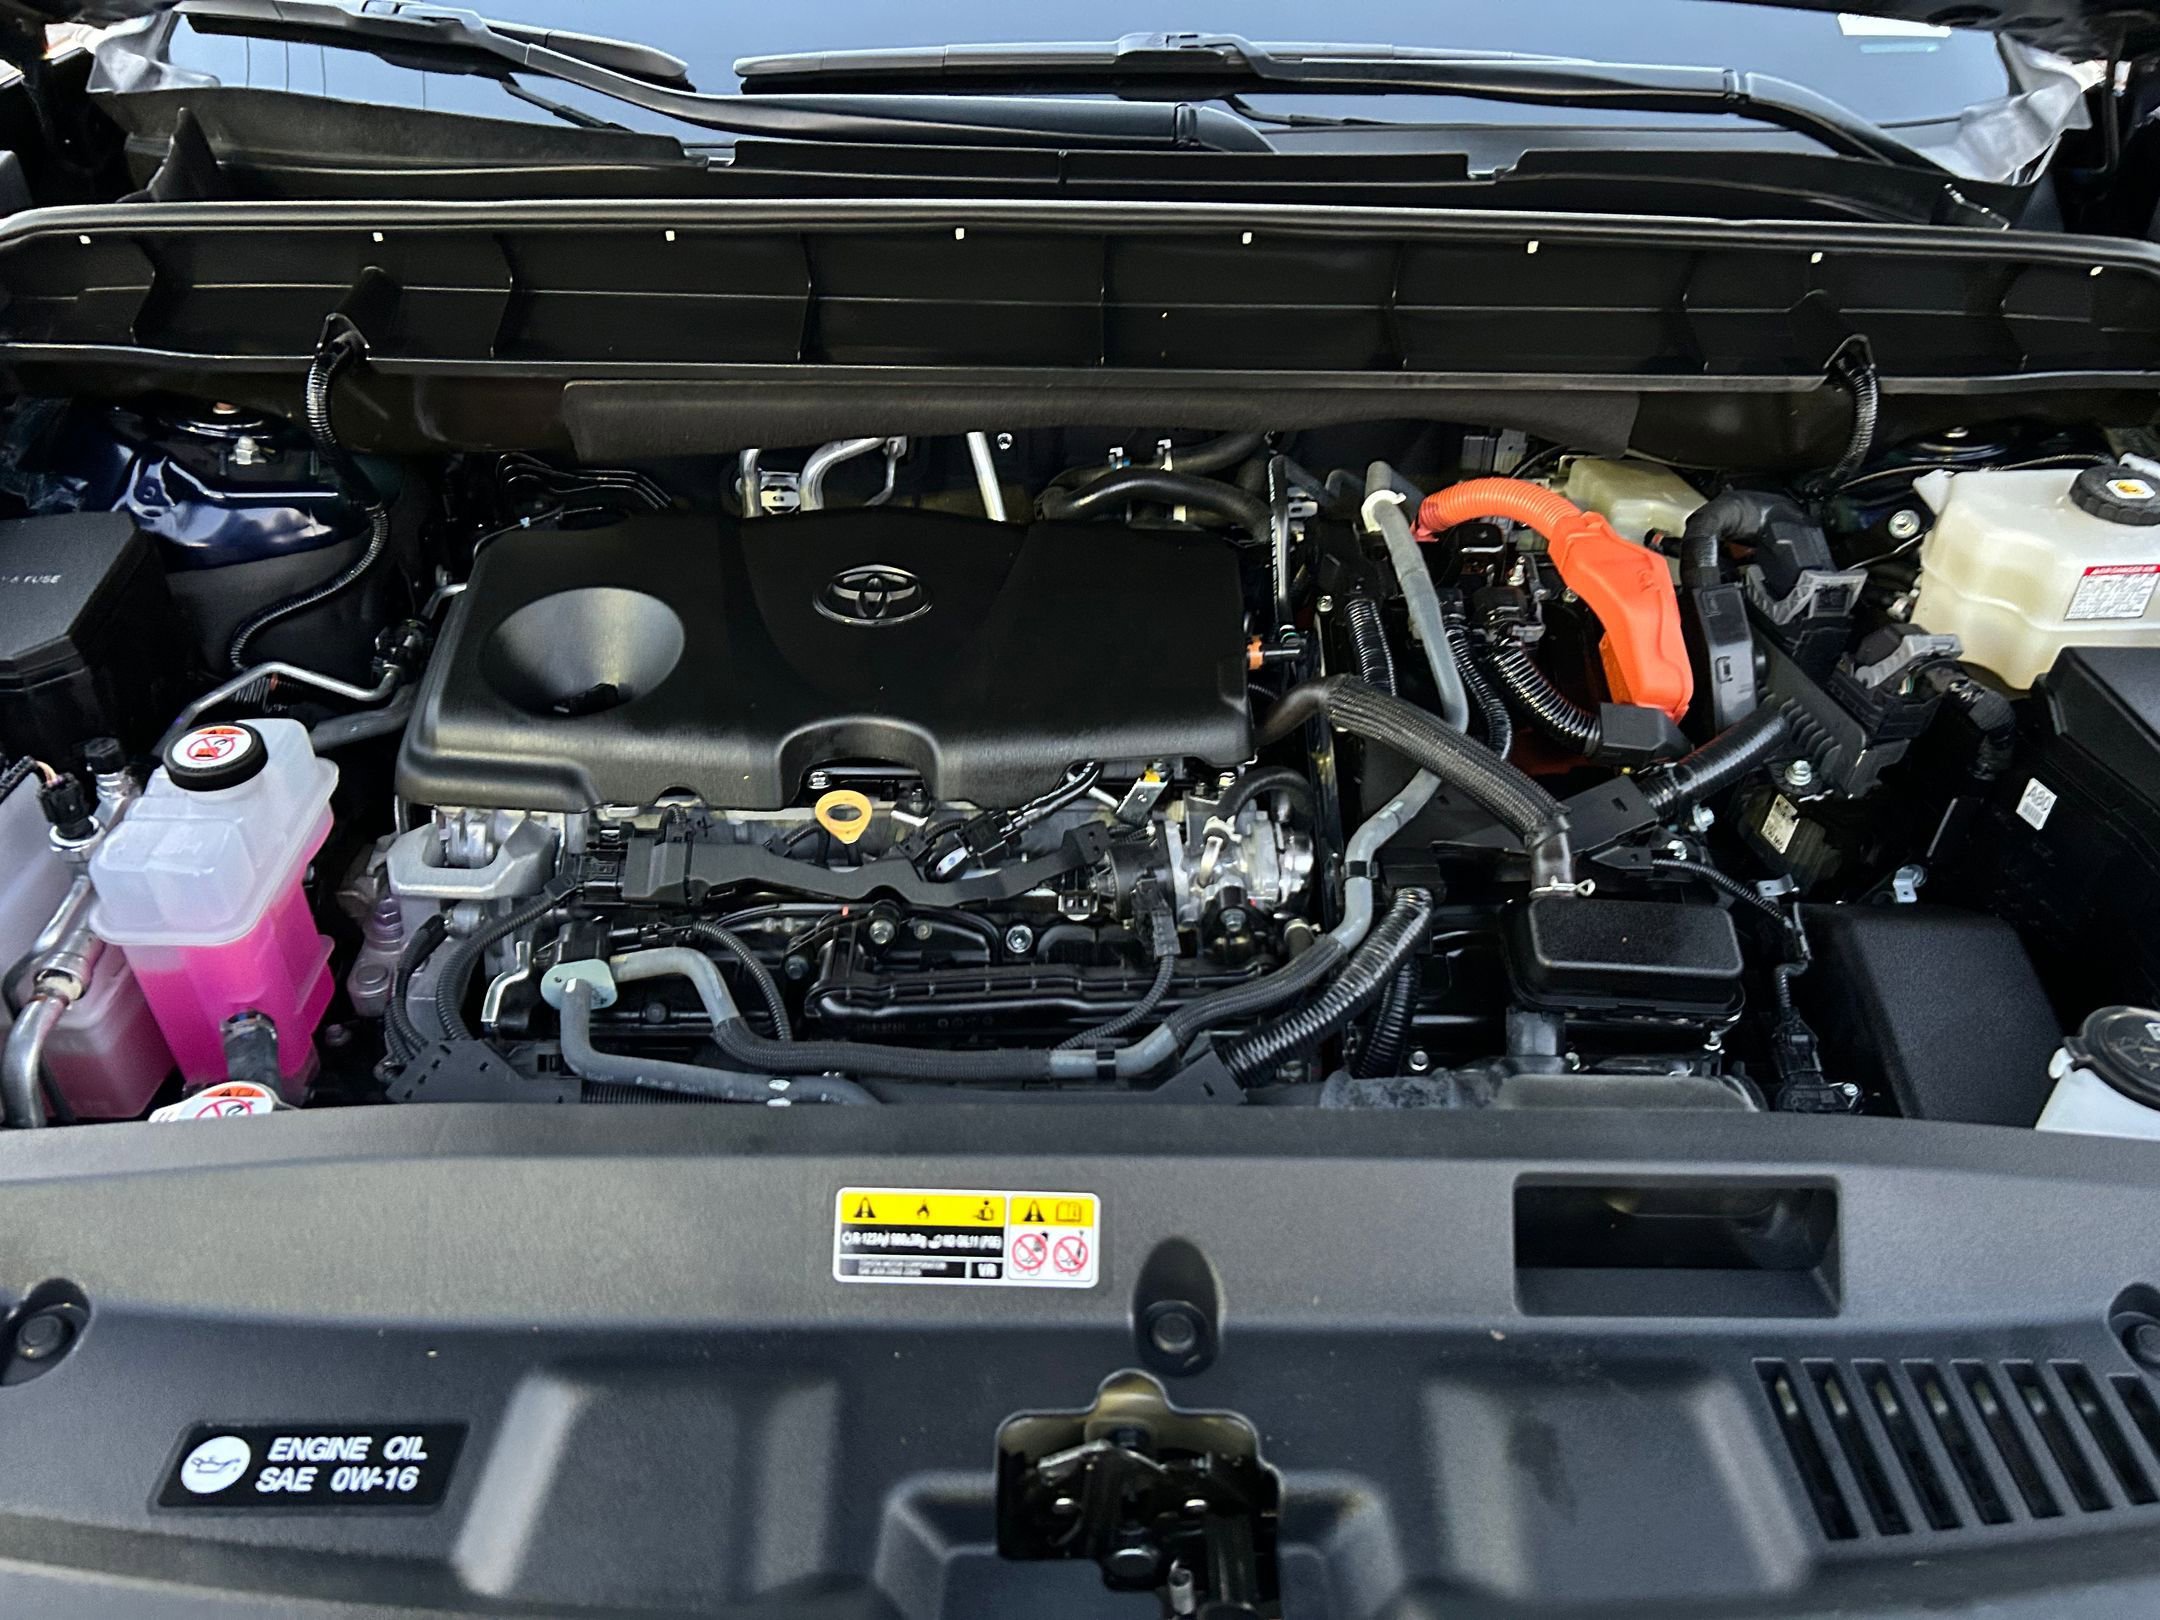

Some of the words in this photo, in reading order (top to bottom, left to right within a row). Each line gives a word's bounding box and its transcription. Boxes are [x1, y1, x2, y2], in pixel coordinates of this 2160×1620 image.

[267, 1436, 372, 1461] ENGINE
[383, 1436, 428, 1461] OIL
[255, 1467, 319, 1492] SAE
[330, 1466, 420, 1492] 0W-16
